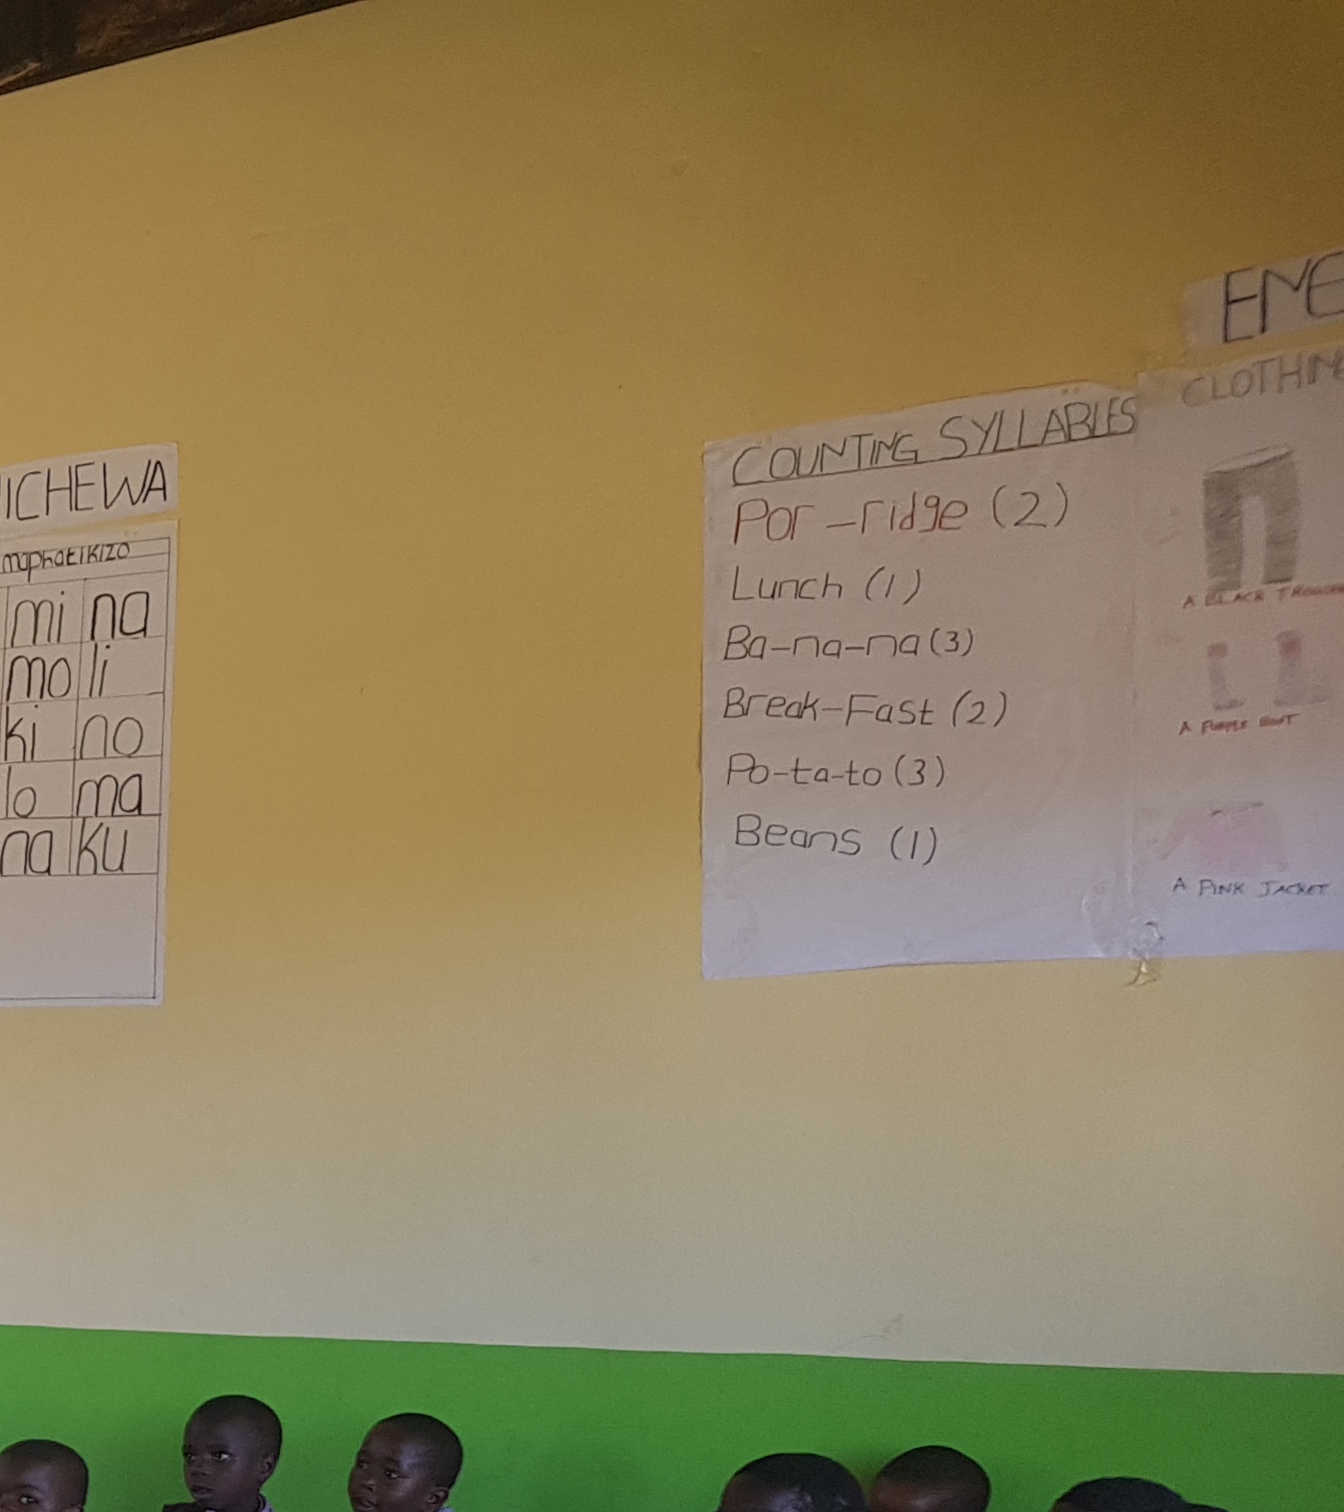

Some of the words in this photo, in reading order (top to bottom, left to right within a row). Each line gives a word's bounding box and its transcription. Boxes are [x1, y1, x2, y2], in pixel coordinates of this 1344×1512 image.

[732, 432, 919, 486] COUNTING
[939, 396, 1136, 458] SYLLABLES
[992, 482, 1069, 528] (2)
[732, 566, 842, 600] Lunch
[865, 566, 921, 604] (1)
[1183, 595, 1195, 609] A
[12, 591, 65, 648] mi
[91, 591, 149, 641] na
[723, 624, 919, 661] Ba-na-na
[930, 627, 974, 657] (3)
[6, 655, 71, 701] mo
[89, 643, 110, 697] li
[952, 690, 1007, 727] (2)
[1179, 721, 1191, 736] A
[80, 715, 143, 759] no
[6, 765, 37, 818] lo
[76, 774, 142, 816] ma
[727, 753, 881, 786] Po-ta-to
[895, 754, 945, 788] (3)
[0, 830, 53, 876] na
[735, 814, 861, 856] Beans
[890, 826, 937, 866] (1)
[1173, 877, 1186, 891] A
[1199, 879, 1245, 897] PINK
